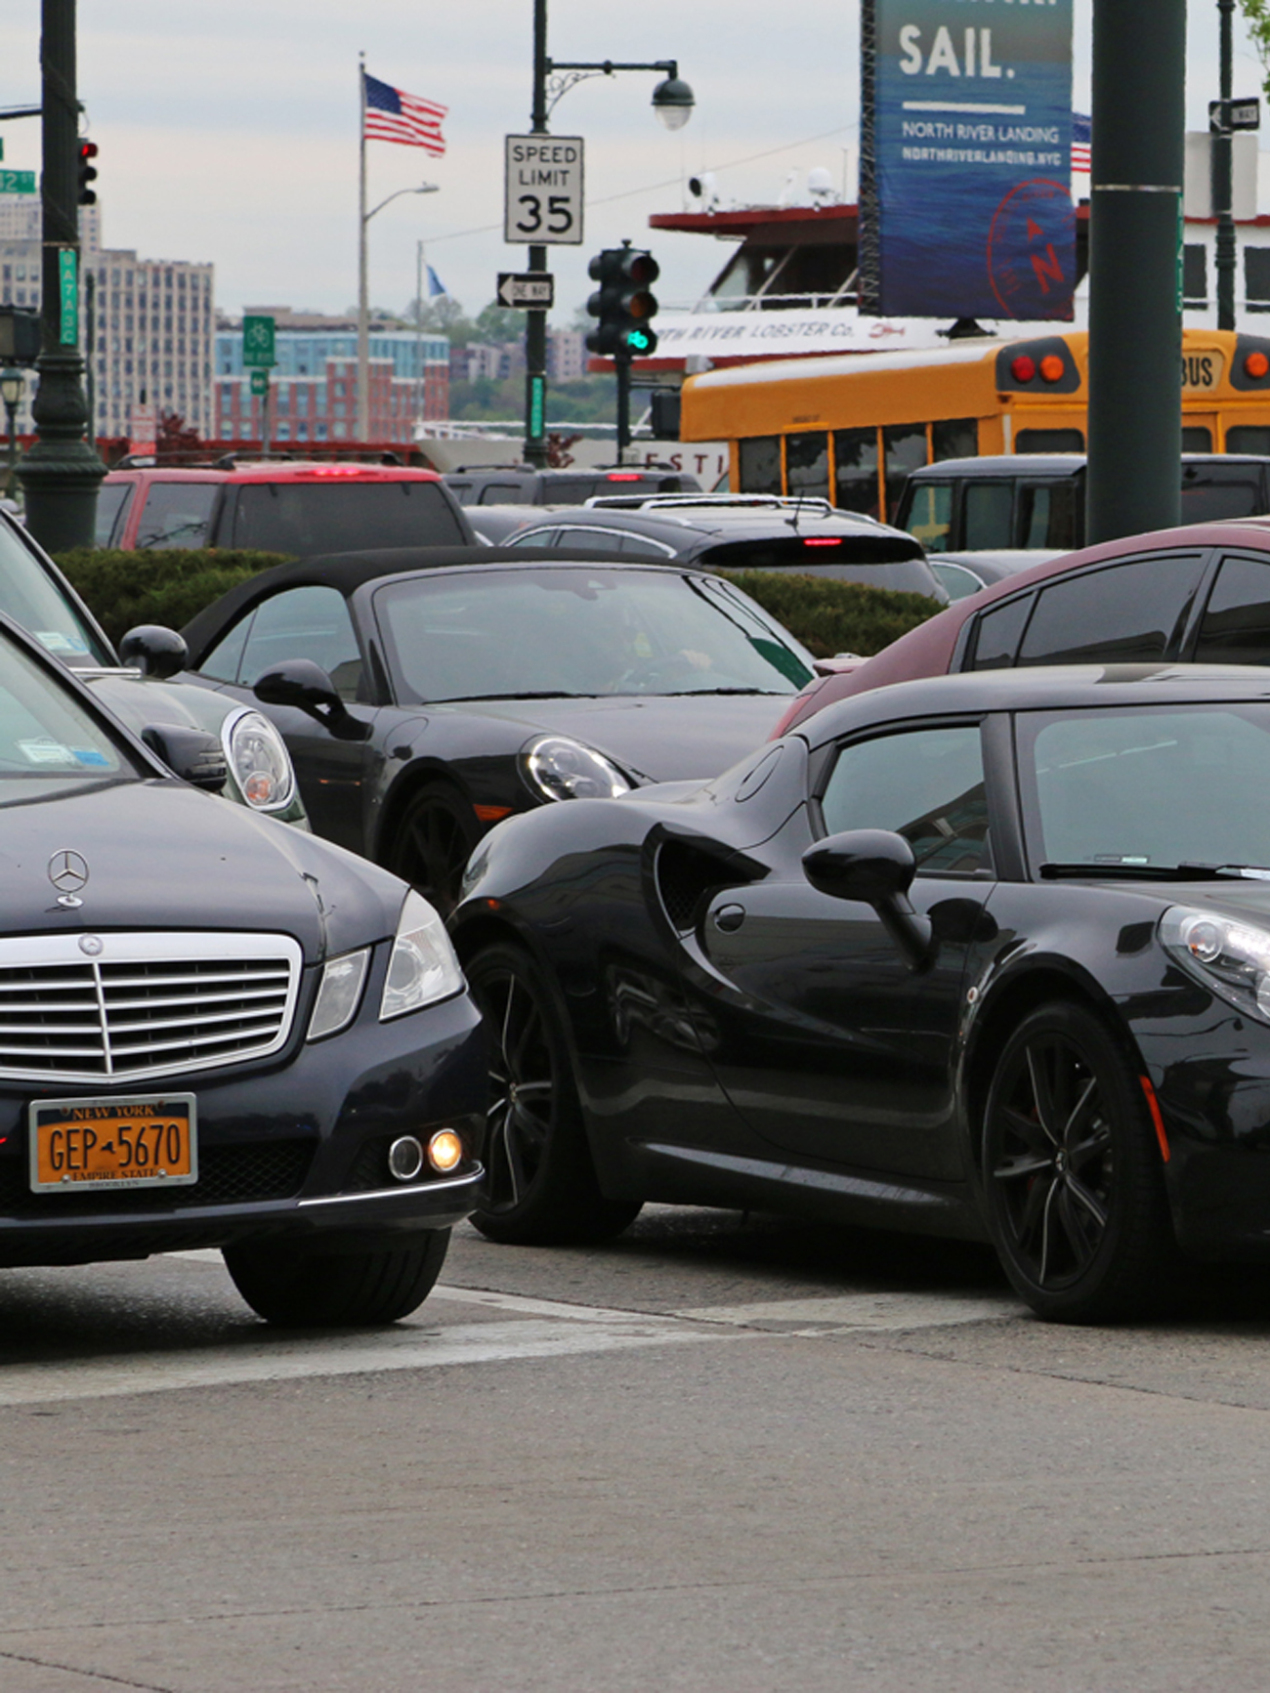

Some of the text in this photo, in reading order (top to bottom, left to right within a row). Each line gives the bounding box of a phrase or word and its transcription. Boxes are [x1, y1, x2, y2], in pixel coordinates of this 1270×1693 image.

[899, 24, 1015, 79] SAIL.
[902, 121, 1060, 144] NORTH RIVER LANDING
[512, 145, 578, 163] SPEED
[902, 146, 1063, 166] NORTHRIVERLANDING.NYC
[519, 169, 570, 186] LIMIT
[515, 195, 574, 234] 35
[689, 325, 746, 340] RIVER
[750, 321, 831, 339] LOBSTER
[73, 1104, 156, 1121] NEW YORK
[50, 1123, 181, 1171] GEP 5670
[73, 1168, 157, 1182] EMPIRE STATE
